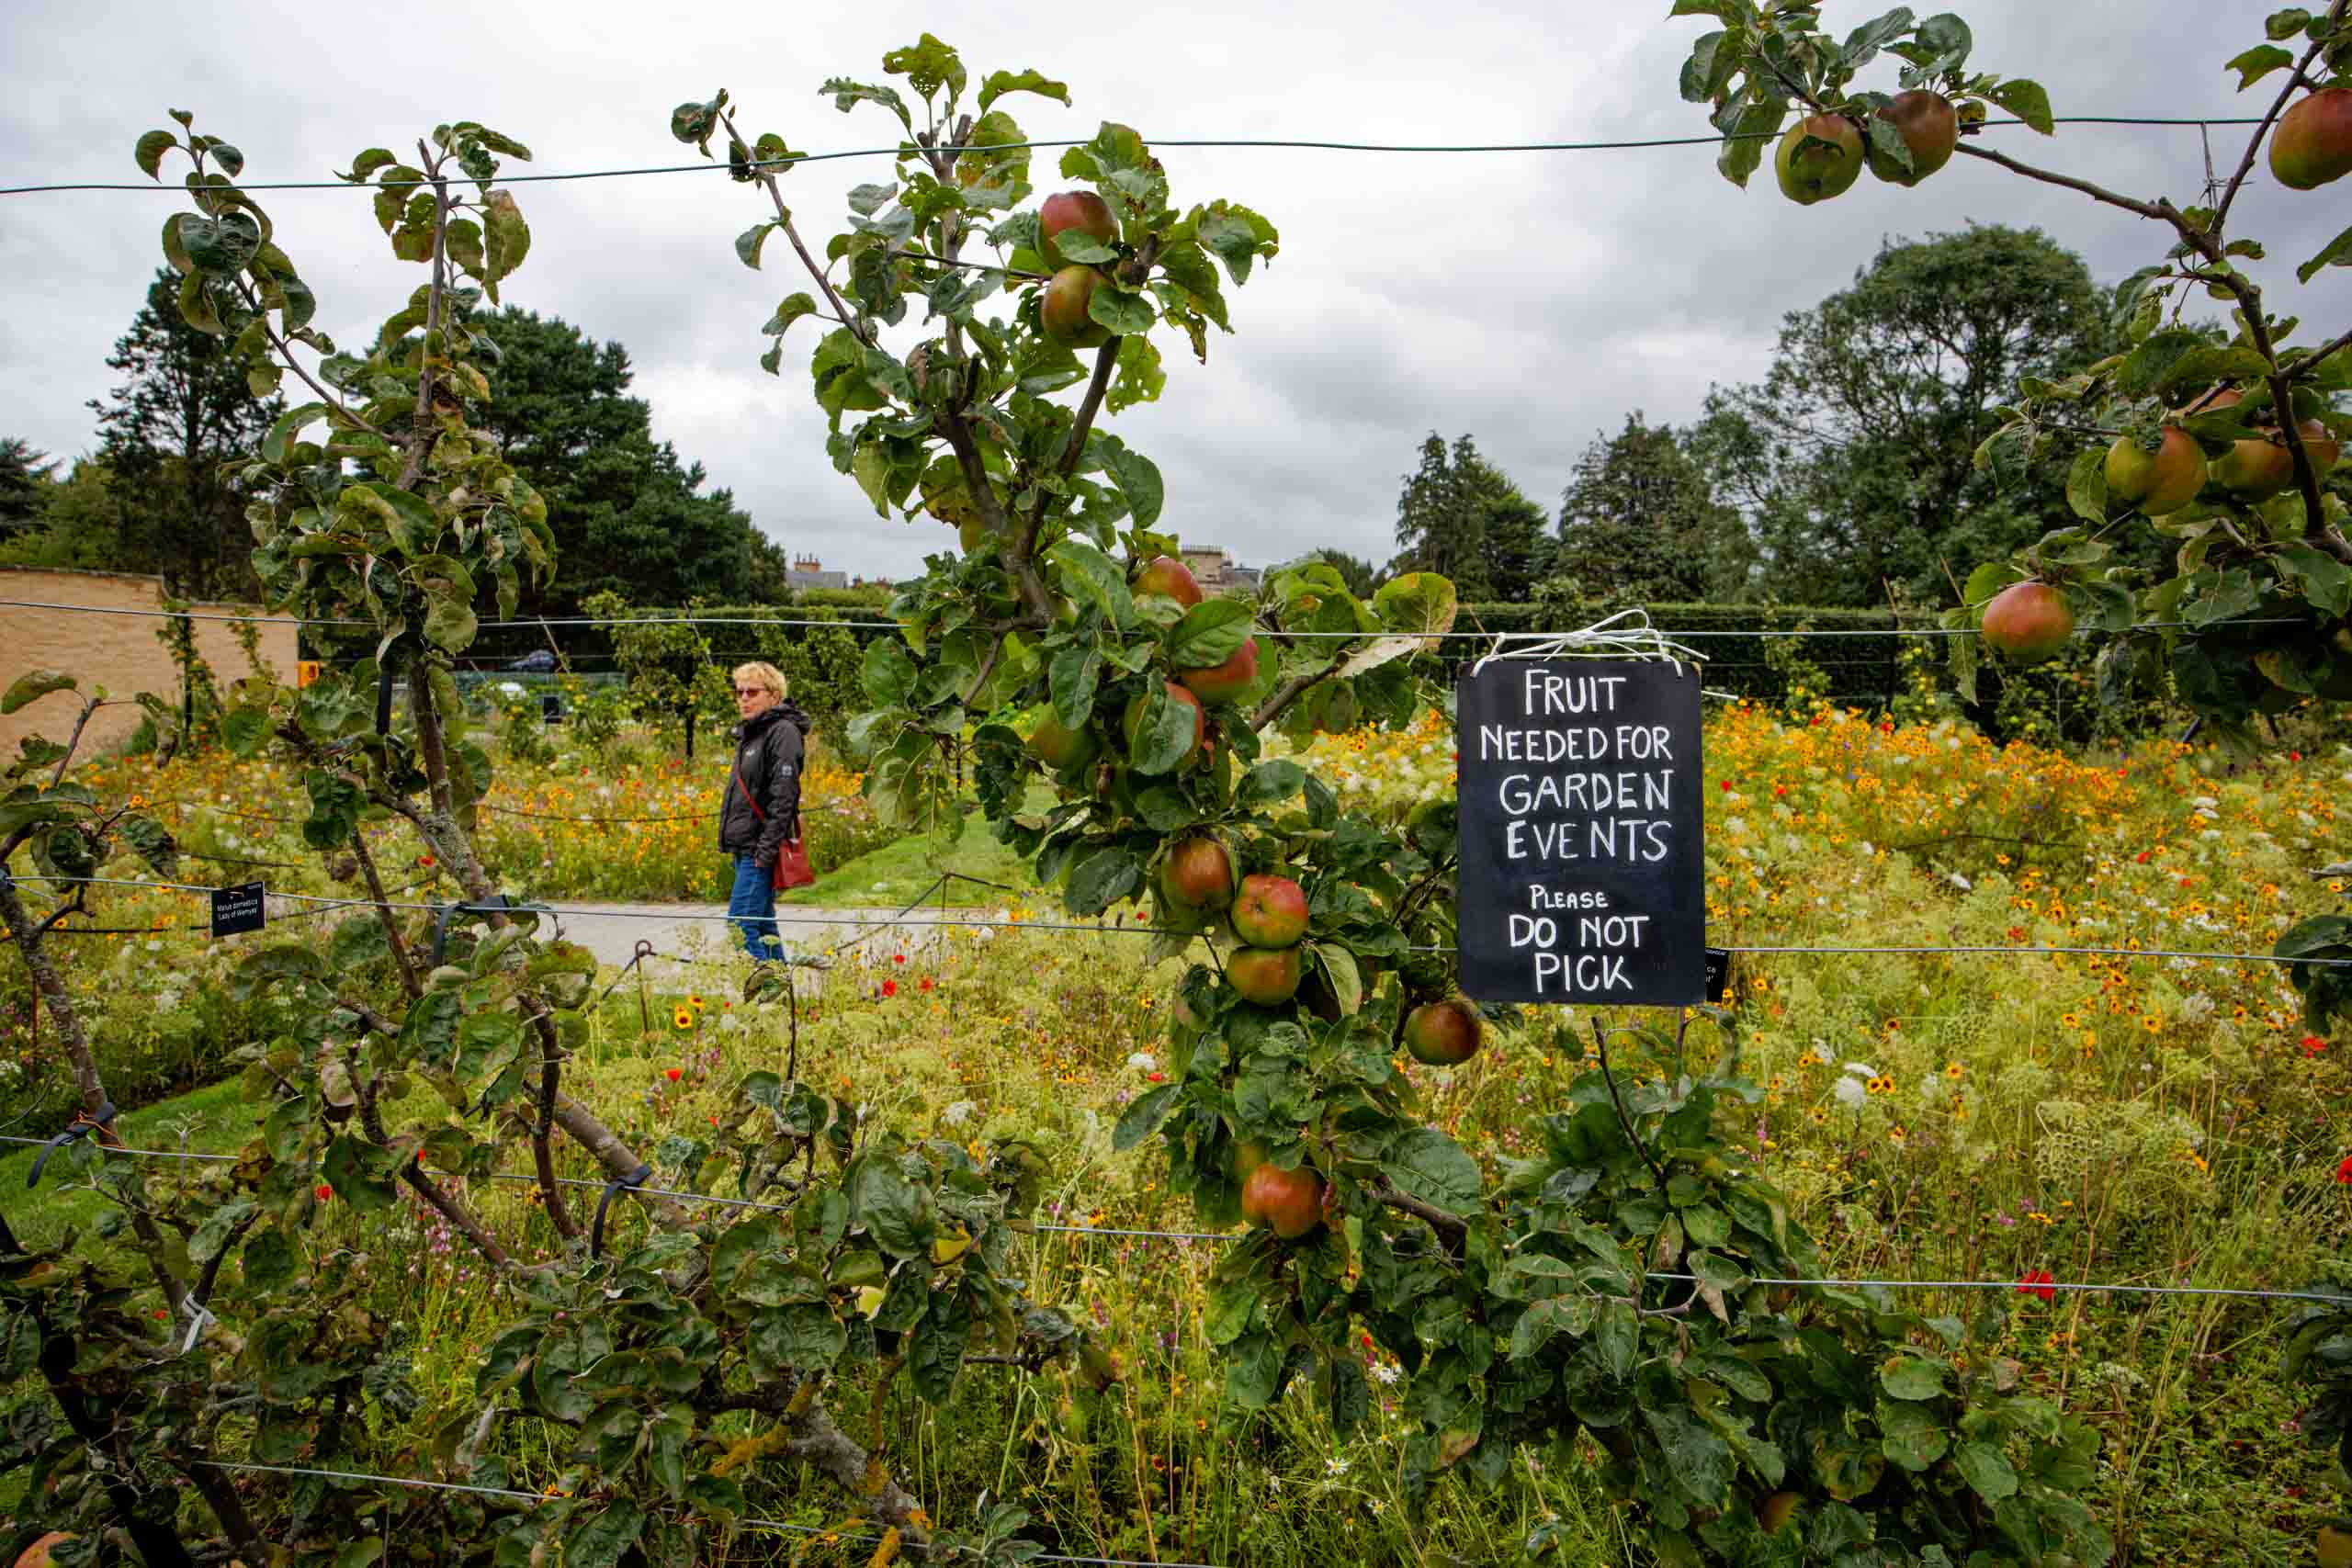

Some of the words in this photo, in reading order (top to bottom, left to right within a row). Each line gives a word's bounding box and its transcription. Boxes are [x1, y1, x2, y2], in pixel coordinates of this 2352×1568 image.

[1524, 669, 1627, 716] FRUIT
[1480, 724, 1609, 763] NEEDED
[1615, 725, 1674, 761] FOR
[1499, 769, 1675, 816] GARDEN
[1507, 817, 1672, 863] EVENTS
[1529, 884, 1609, 910] PLEASE
[1509, 914, 1557, 949] DO
[1581, 915, 1650, 949] NOT
[1534, 953, 1634, 993] PICK
